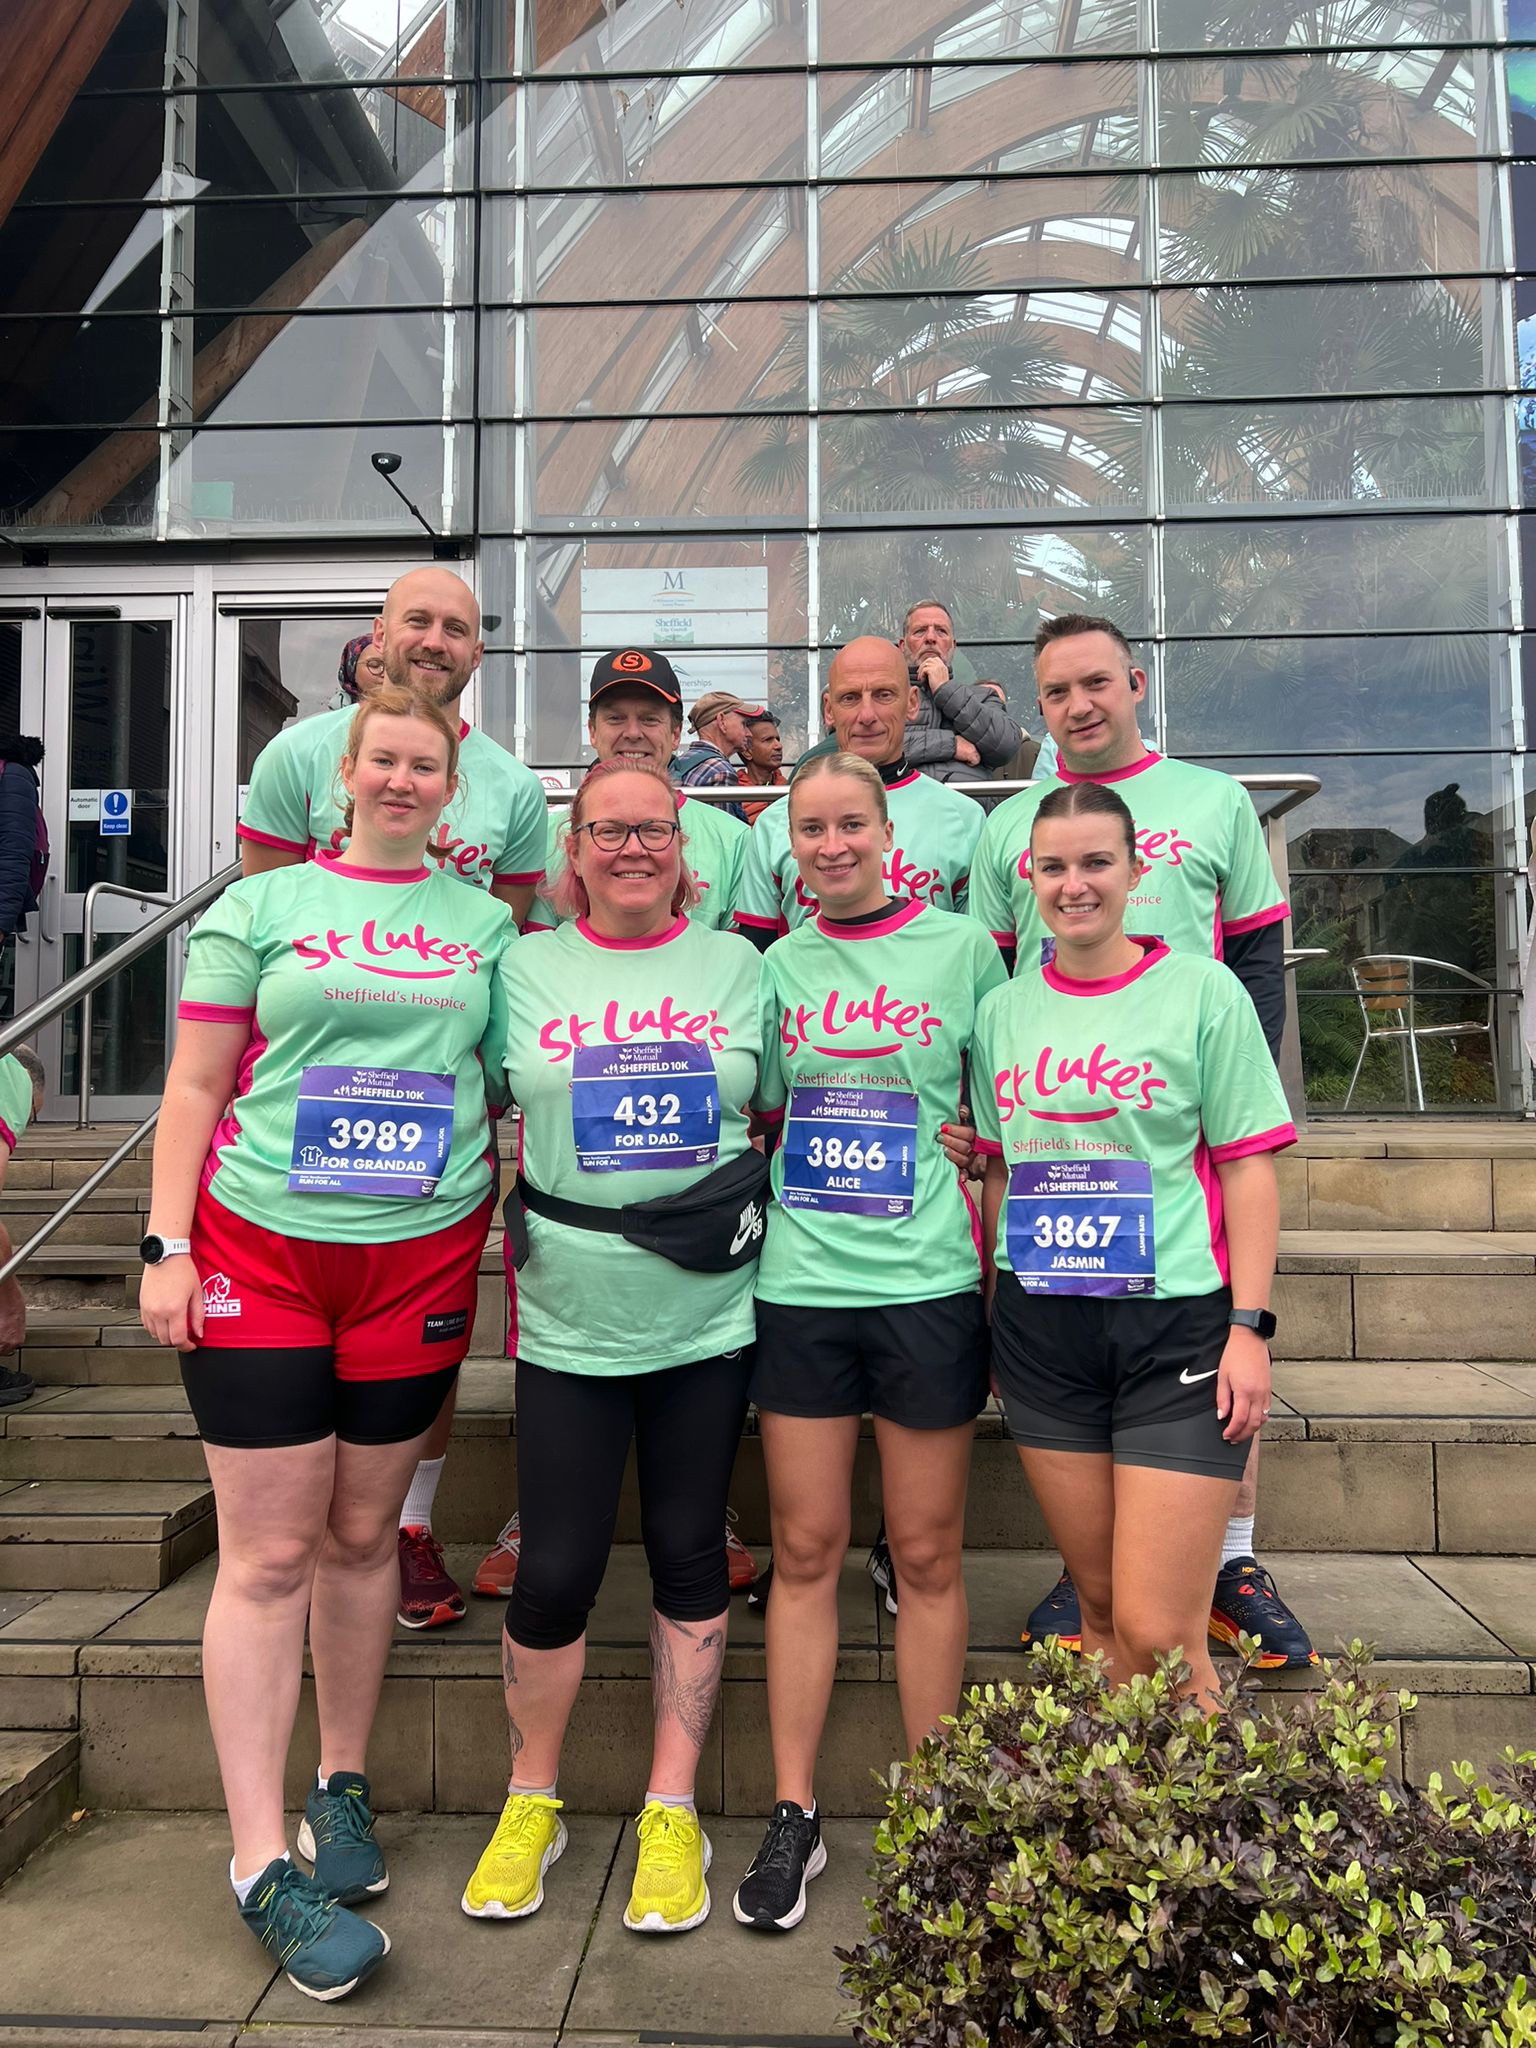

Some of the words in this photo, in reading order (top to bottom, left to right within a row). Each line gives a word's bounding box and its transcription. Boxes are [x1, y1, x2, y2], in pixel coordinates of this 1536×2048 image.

[663, 571, 686, 590] M
[655, 618, 692, 627] Sheffield
[623, 655, 640, 667] S
[437, 823, 493, 885] ke's
[292, 929, 354, 970] St
[362, 919, 484, 974] Luke's
[324, 987, 407, 1004] Sheffield's
[411, 992, 466, 1011] Hospice
[780, 1004, 817, 1057] St
[823, 984, 943, 1047] Luke's
[539, 1014, 597, 1063] St
[603, 996, 729, 1051] Luke's
[633, 1045, 662, 1055] Sheffield
[633, 1053, 658, 1061] Mutual
[619, 1062, 669, 1074] SHEFFIELD
[670, 1060, 689, 1071] 10K
[367, 1071, 399, 1081] Sheffield
[367, 1079, 394, 1087] Mutual
[797, 1072, 857, 1089] Sheffield's
[860, 1073, 912, 1087] Hospice
[994, 1063, 1030, 1122] St
[1034, 1043, 1167, 1110] Luke's
[351, 1086, 405, 1099] SHEFFIELD
[405, 1090, 425, 1100] 10K
[836, 1091, 863, 1100] Sheffield
[835, 1098, 859, 1106] Mutual
[613, 1093, 681, 1126] 432
[823, 1106, 868, 1117] SHEFFIELD
[870, 1109, 888, 1120] 10K
[328, 1117, 423, 1153] 3989
[615, 1134, 644, 1147] FOR
[648, 1133, 683, 1145] DAD.
[1013, 1138, 1071, 1155] Sheffield's
[1074, 1138, 1132, 1155] Hospice
[806, 1136, 887, 1172] 3866
[320, 1156, 349, 1169] FOR
[353, 1158, 427, 1172] GRANDAD
[1061, 1163, 1090, 1172] Sheffield
[826, 1176, 861, 1189] ALICE
[1049, 1181, 1098, 1192] SHEFFIELD
[1099, 1180, 1119, 1191] 10K
[752, 1218, 763, 1240] SB
[1033, 1215, 1122, 1249] 3867
[1050, 1256, 1105, 1270] JASMIN
[204, 1302, 241, 1313] HINO
[427, 1320, 444, 1328] TEAM
